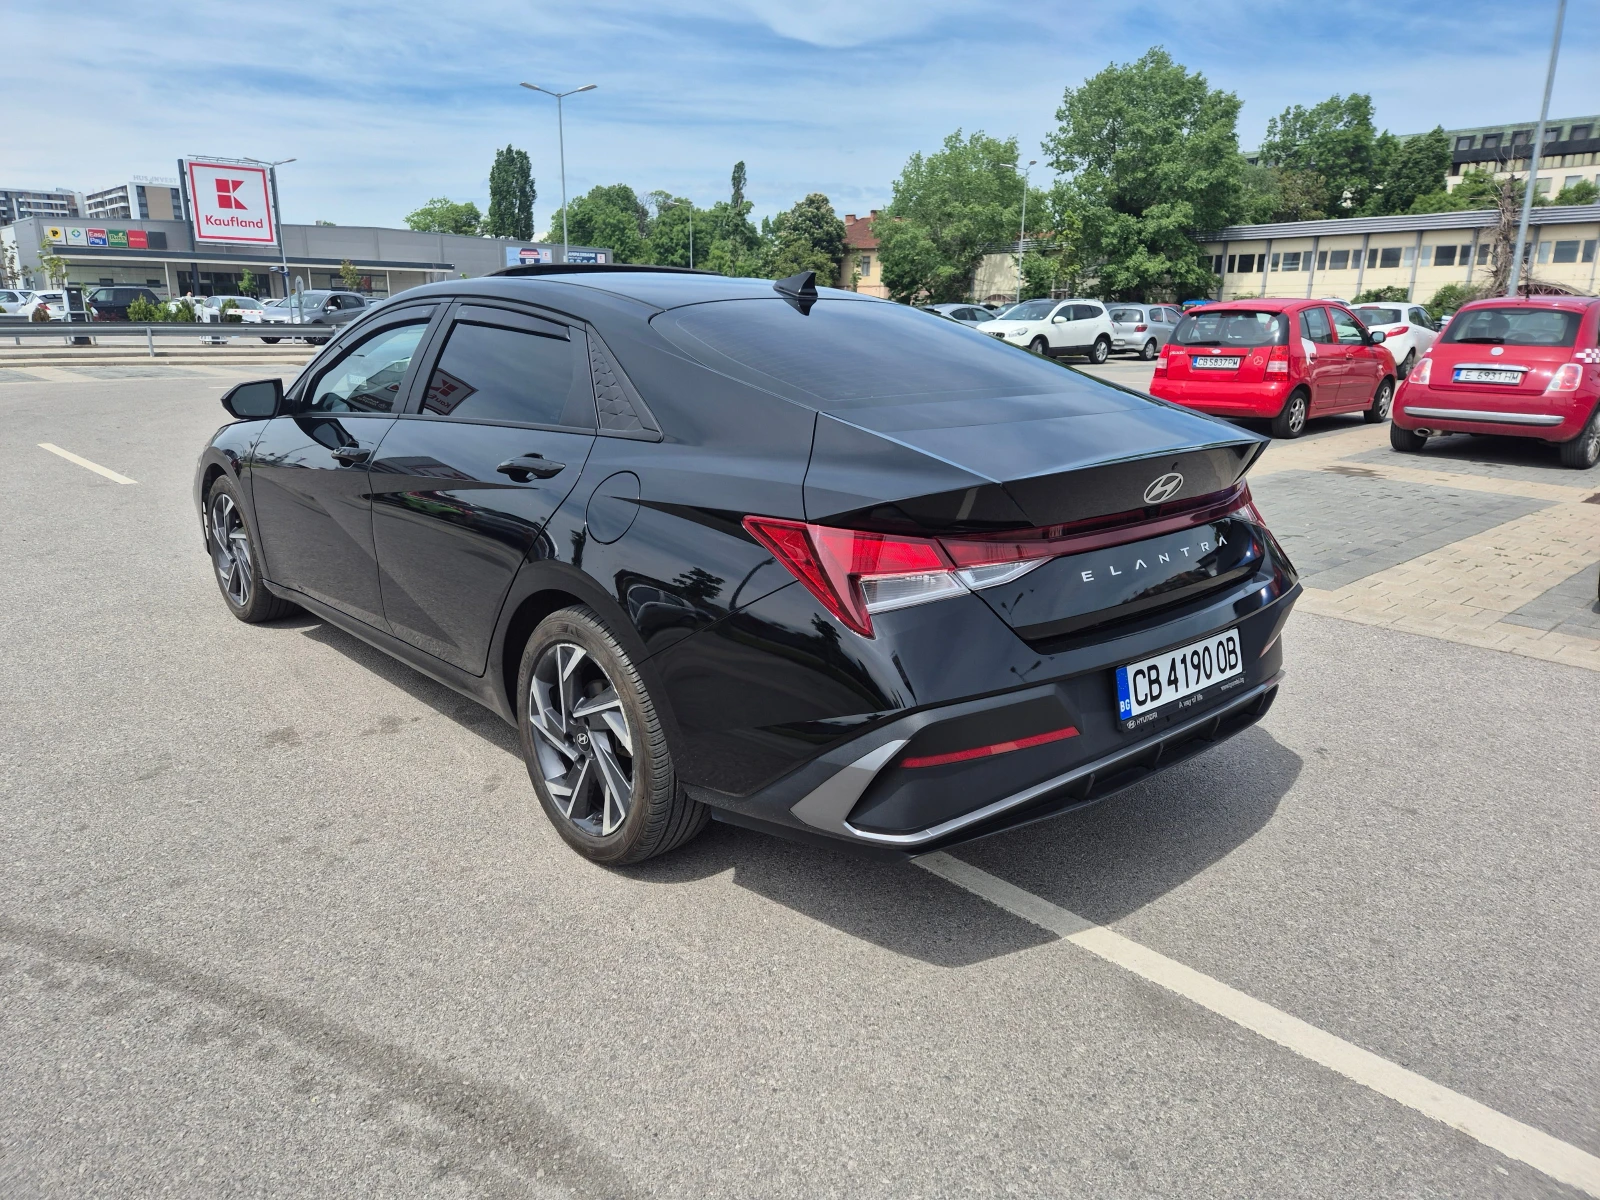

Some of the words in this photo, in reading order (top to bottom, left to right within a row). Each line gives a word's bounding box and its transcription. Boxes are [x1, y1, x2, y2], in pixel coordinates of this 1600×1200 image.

[205, 214, 264, 229] Kaufland
[89, 231, 106, 239] Easy
[90, 237, 103, 245] Pay
[1198, 358, 1208, 367] CB
[1209, 358, 1227, 367] 5837
[1464, 370, 1473, 380] E
[1477, 371, 1502, 381] 6931
[1081, 535, 1228, 582] ELANTRA
[1132, 664, 1163, 707] CB
[1167, 646, 1213, 693] 4190
[1216, 636, 1239, 674] OB
[1120, 700, 1131, 712] BG
